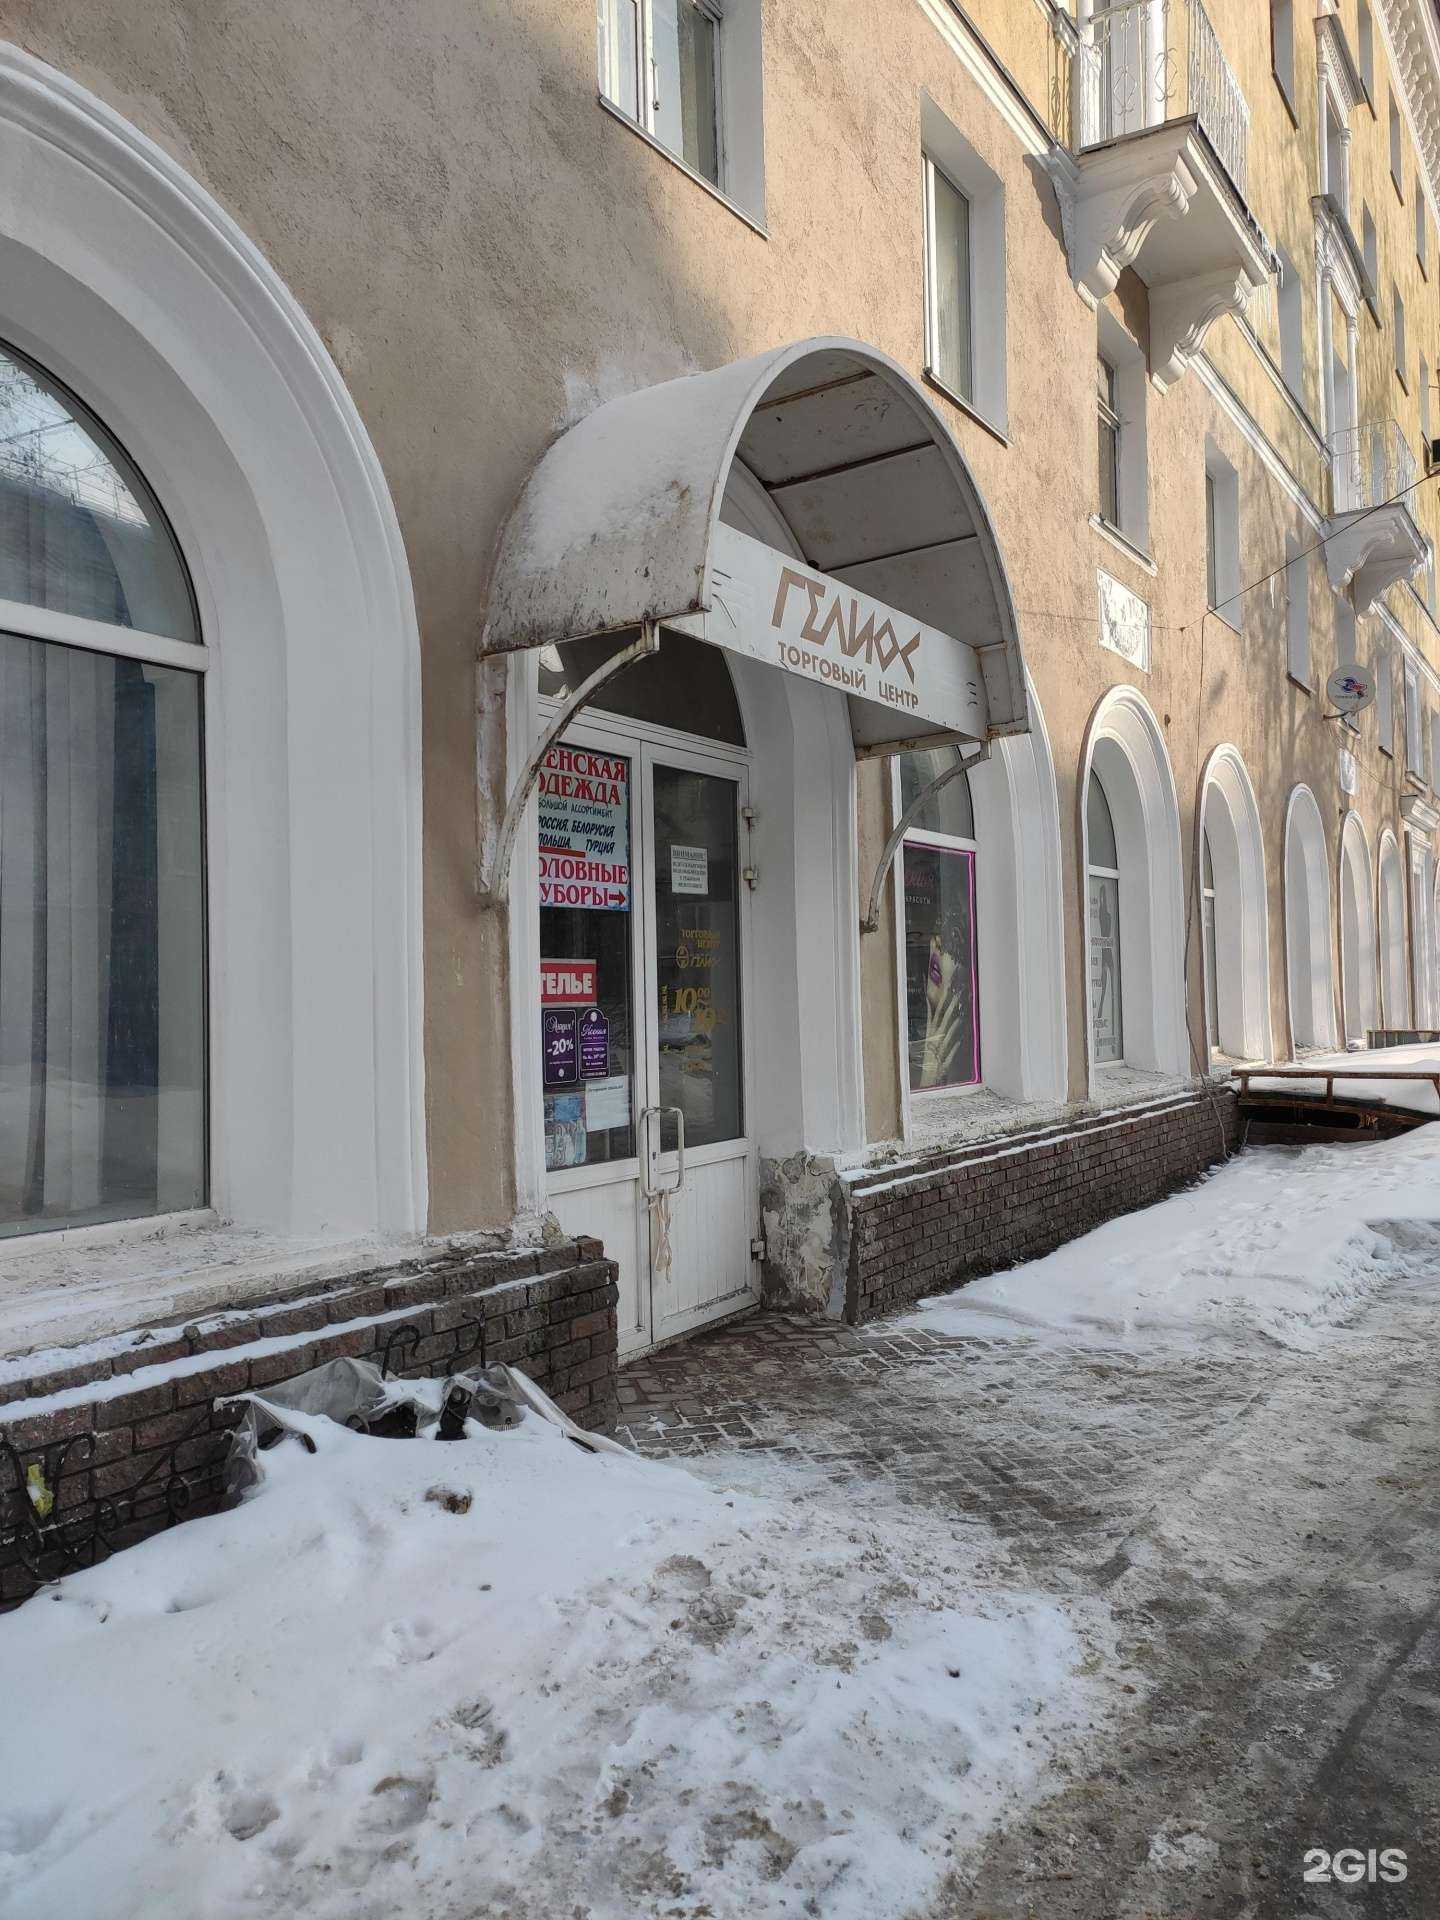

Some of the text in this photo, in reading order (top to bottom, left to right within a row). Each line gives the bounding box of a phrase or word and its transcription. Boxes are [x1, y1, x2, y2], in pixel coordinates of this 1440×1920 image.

[771, 566, 921, 686] ГЕЛИОС
[777, 640, 919, 709] ТОРГОВЫЙ ЦЕНТР
[541, 748, 626, 783] ЕНСКАЯ
[585, 838, 616, 856] ТУРЦИЯ
[538, 857, 629, 885] ОЛОВНЫЕ
[539, 882, 609, 907] УБОРЫ
[540, 972, 593, 995] ТЕЛЬЕ
[546, 1038, 574, 1056] -20%
